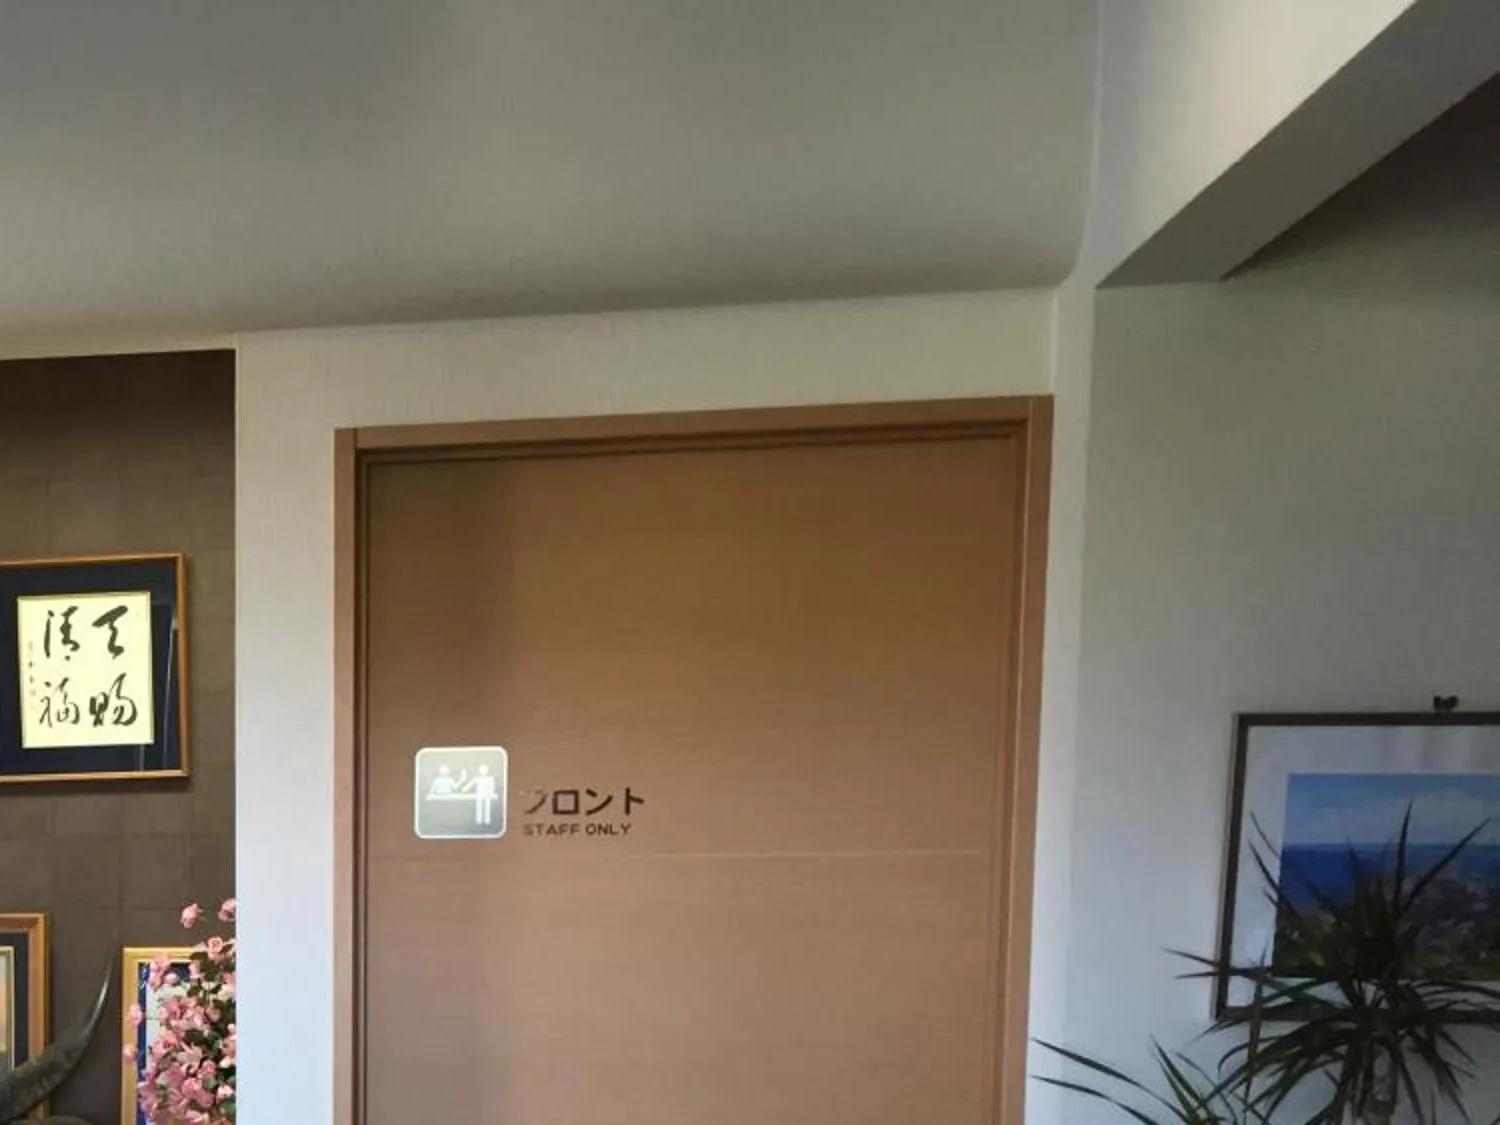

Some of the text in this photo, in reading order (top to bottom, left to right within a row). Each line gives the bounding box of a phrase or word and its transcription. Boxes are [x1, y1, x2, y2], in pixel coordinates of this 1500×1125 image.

[521, 786, 645, 816] フロント
[522, 823, 632, 837] STAFF ONLY
